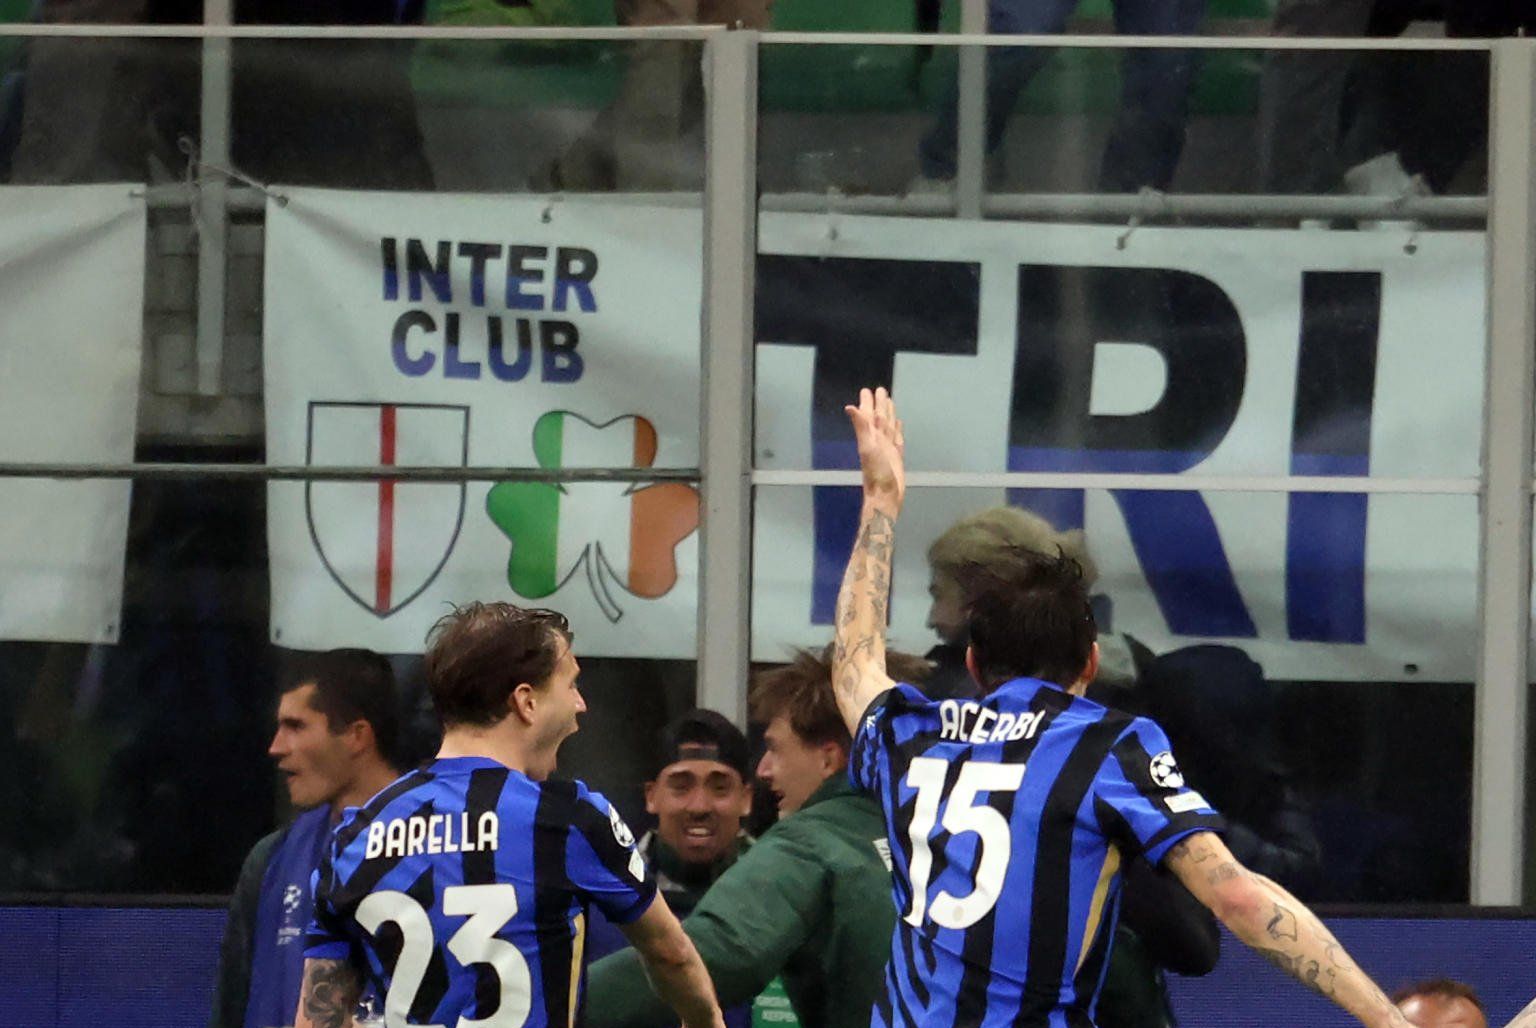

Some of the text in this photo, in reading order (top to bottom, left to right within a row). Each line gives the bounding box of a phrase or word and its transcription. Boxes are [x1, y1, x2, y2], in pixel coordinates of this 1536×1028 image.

[380, 237, 599, 314] INTER
[391, 310, 585, 383] CLUB
[756, 254, 1383, 645] TRI
[939, 699, 1046, 745] ACERBI
[365, 810, 499, 860] BARELLA
[902, 756, 1027, 930] 15
